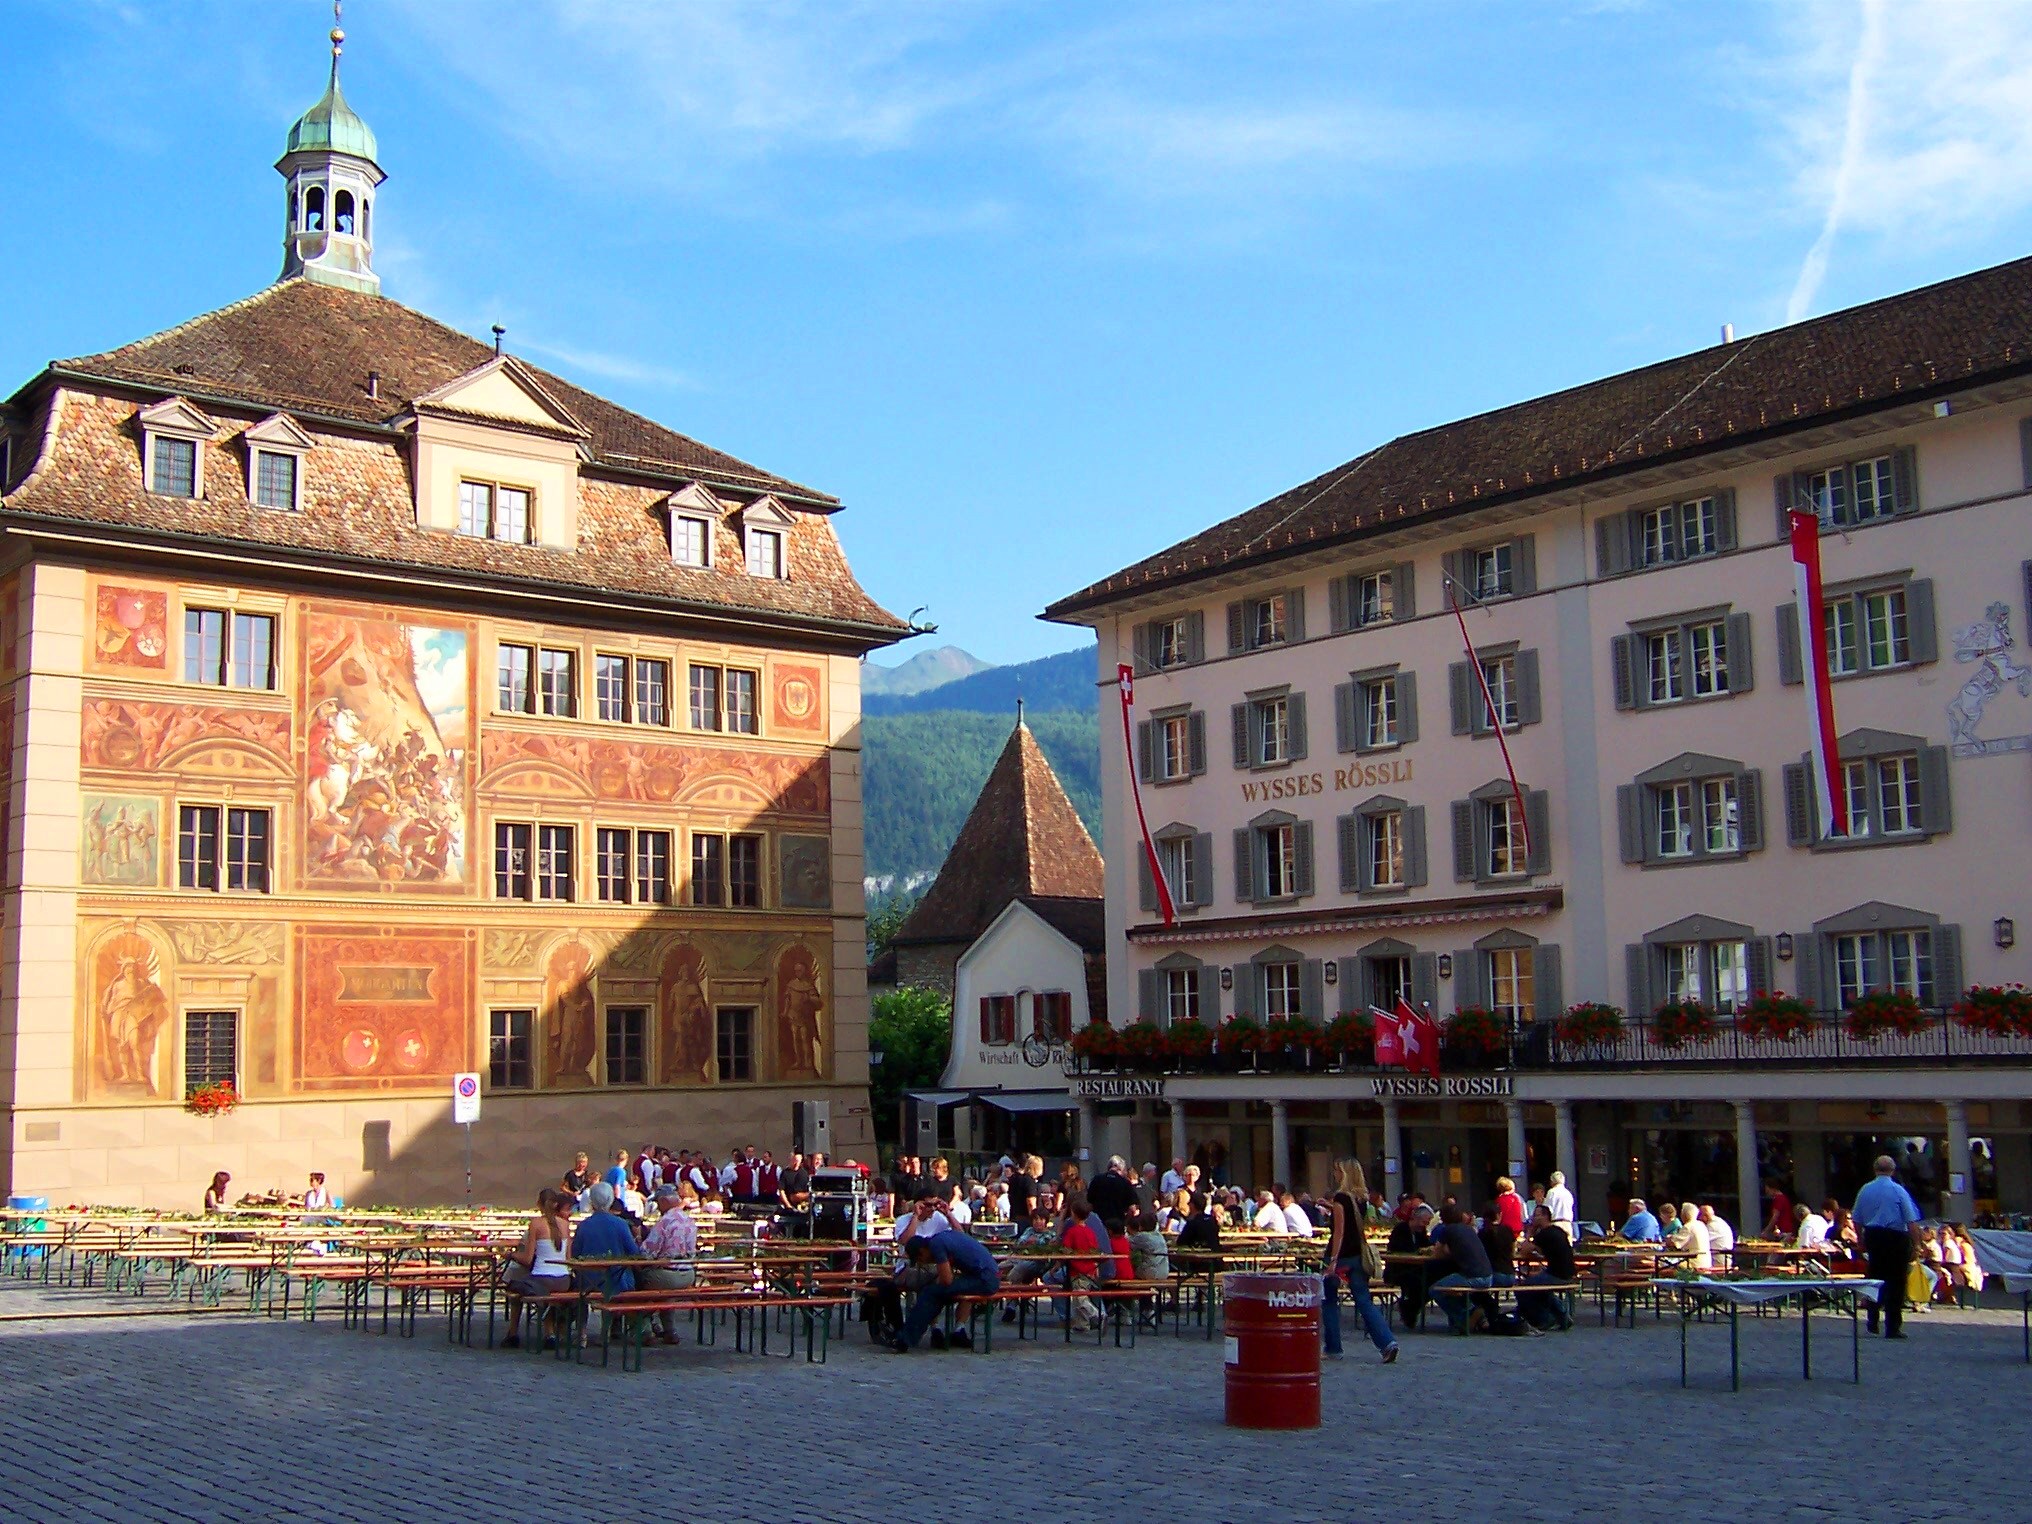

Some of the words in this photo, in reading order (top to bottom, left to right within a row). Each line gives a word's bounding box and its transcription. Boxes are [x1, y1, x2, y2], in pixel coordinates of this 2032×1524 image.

[1241, 773, 1324, 802] WYSSES
[1334, 759, 1413, 792] RÖSSLI
[979, 1051, 1019, 1065] Wirtschaft
[1077, 1080, 1162, 1095] RESTAURANT
[1370, 1077, 1439, 1096] WYSSES
